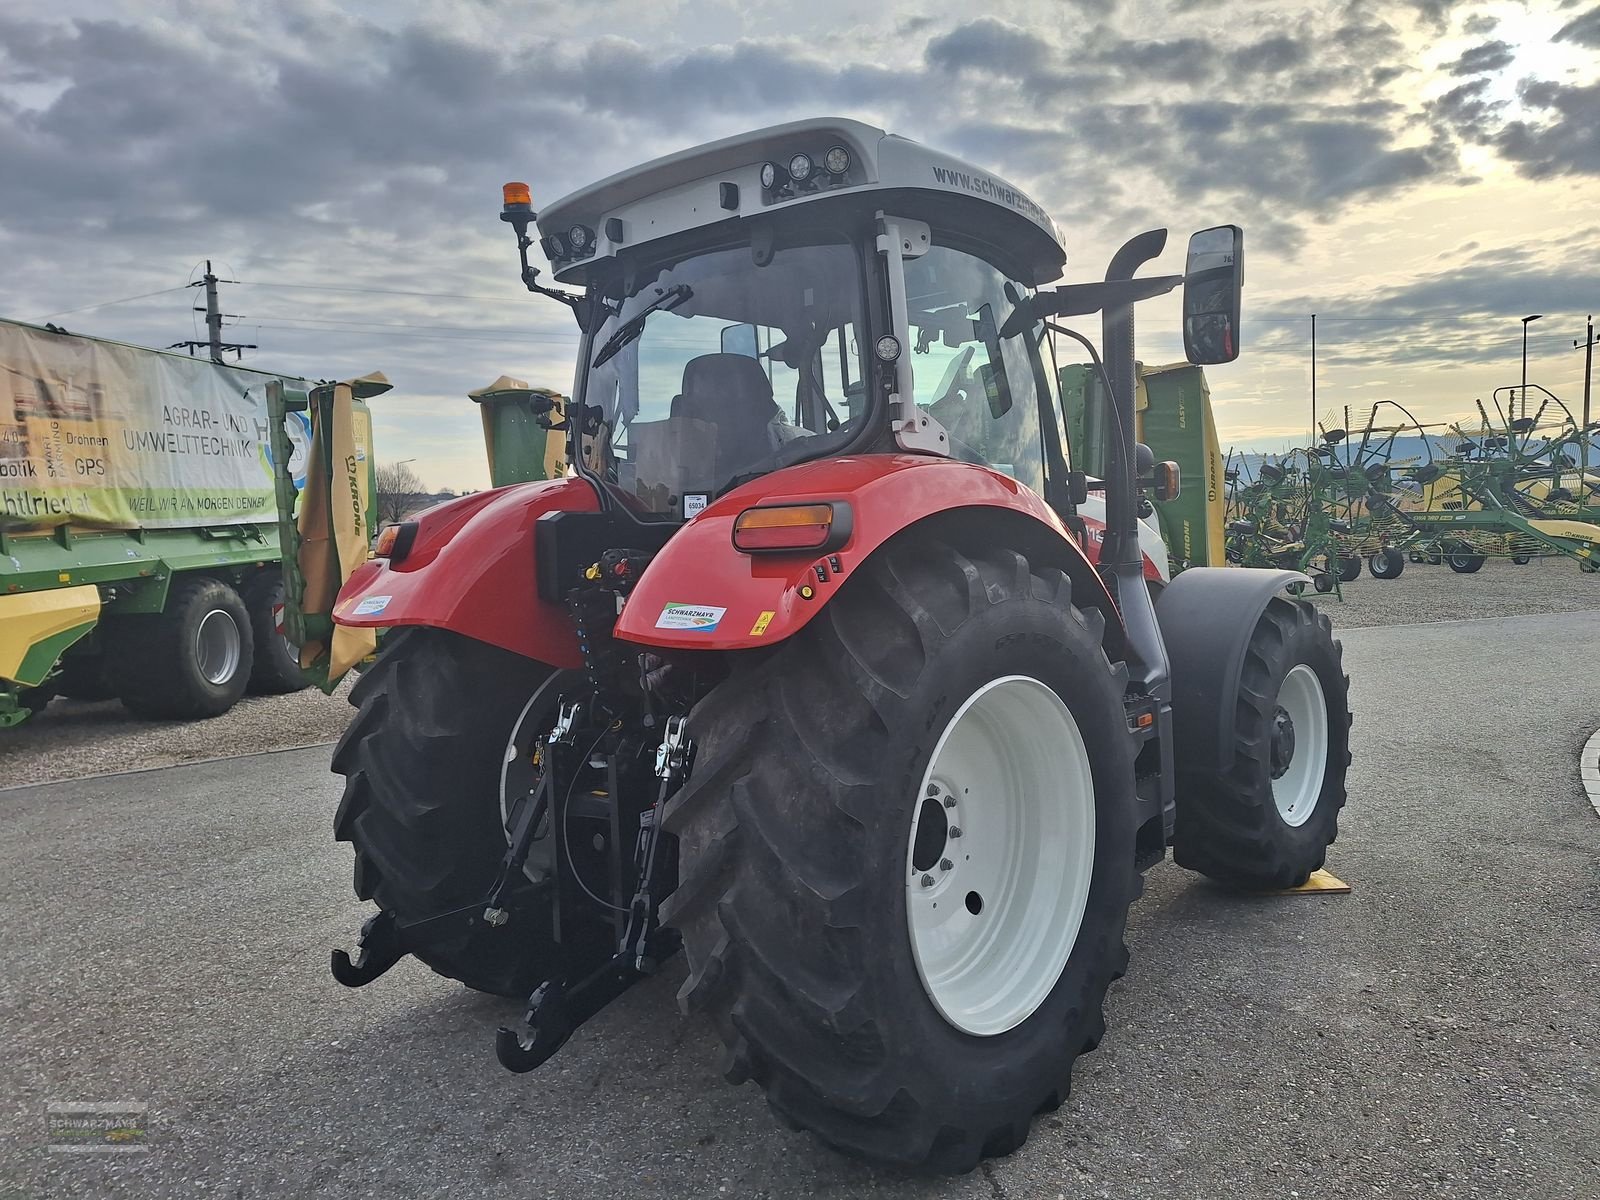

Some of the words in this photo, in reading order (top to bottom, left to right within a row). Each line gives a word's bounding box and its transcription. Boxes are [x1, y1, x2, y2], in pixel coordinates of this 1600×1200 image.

[163, 405, 218, 429] AGRAR-
[222, 414, 248, 433] UND
[66, 432, 109, 446] Drohnen
[123, 430, 252, 457] UMWELTTECHNIK
[42, 436, 56, 478] SMART
[75, 458, 105, 476] GPS
[129, 498, 155, 512] WEIL
[160, 498, 177, 511] WIR
[181, 498, 194, 511] AN
[197, 497, 234, 511] MORGEN
[349, 476, 361, 537] KRONE
[667, 608, 714, 618] SCHWARZMAYR
